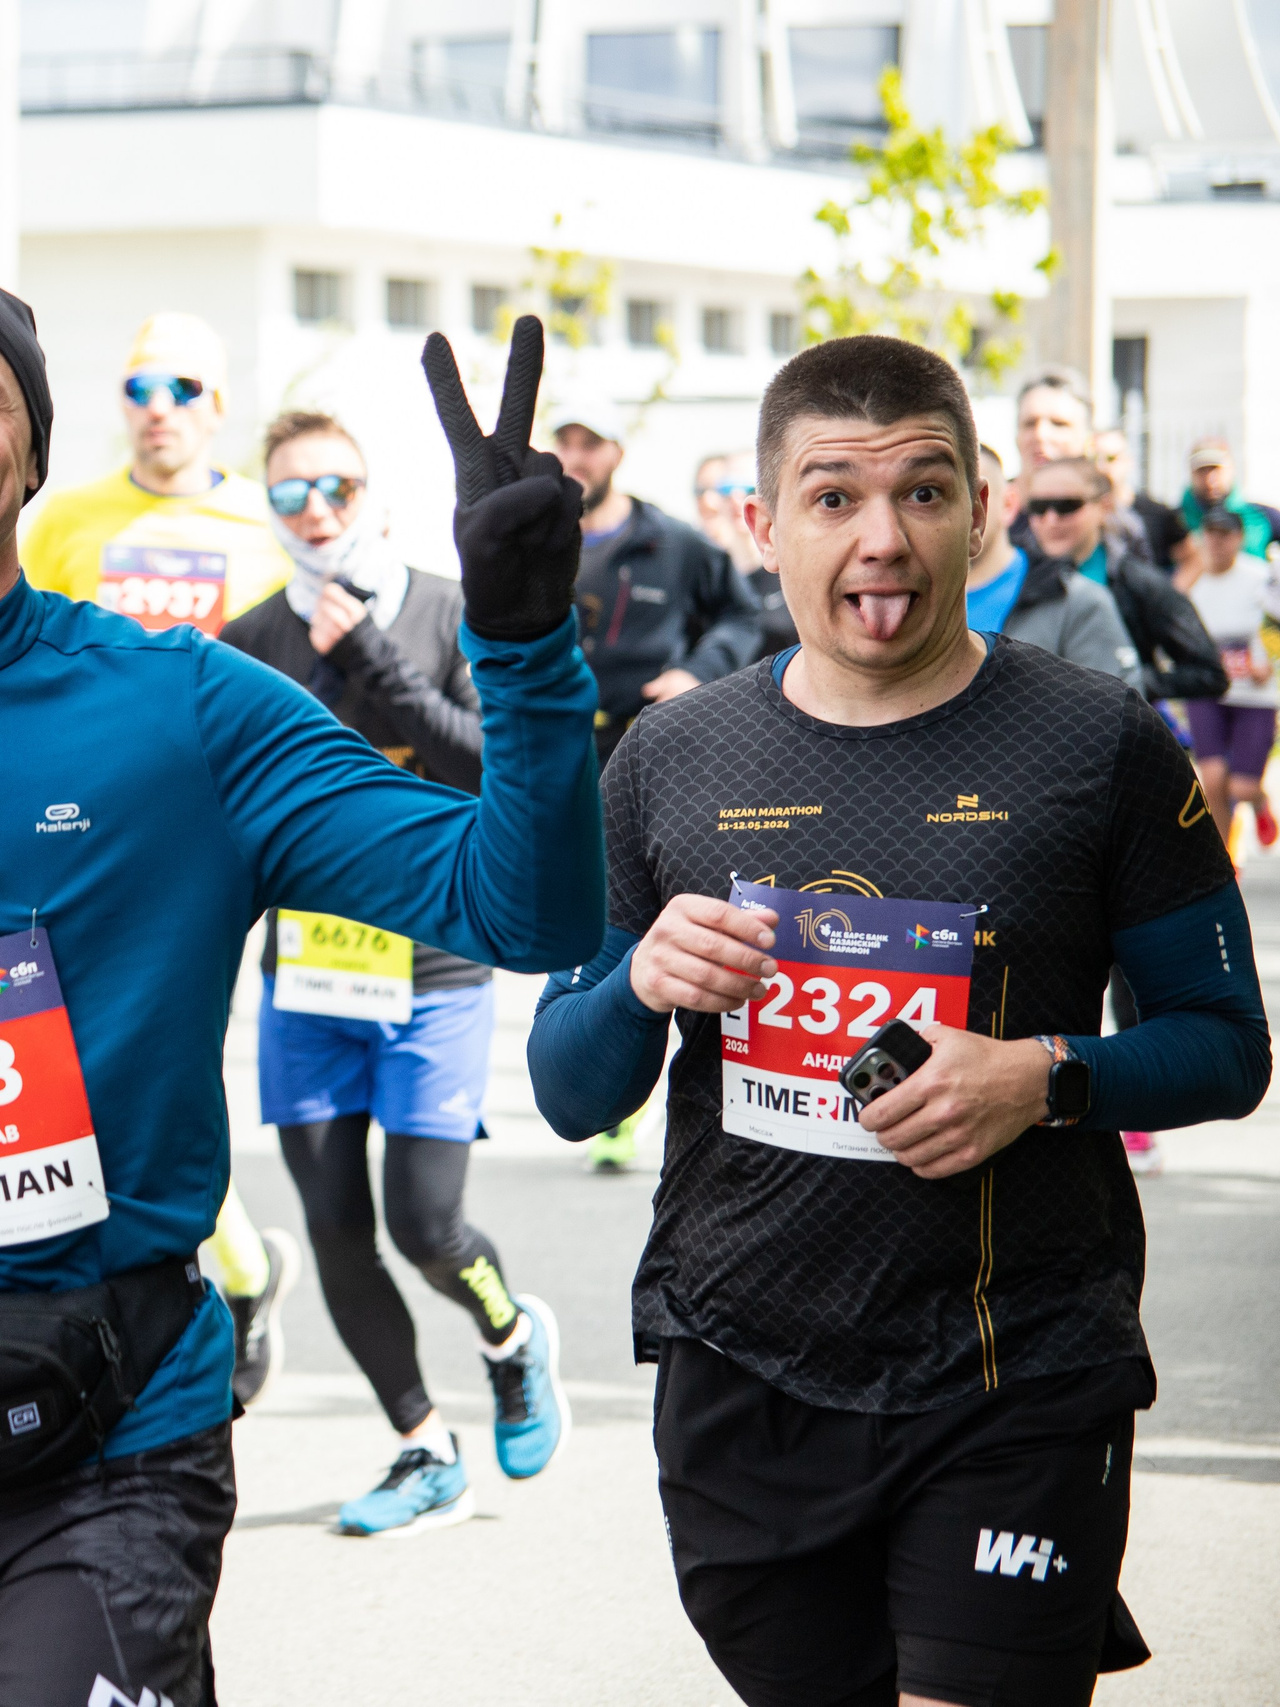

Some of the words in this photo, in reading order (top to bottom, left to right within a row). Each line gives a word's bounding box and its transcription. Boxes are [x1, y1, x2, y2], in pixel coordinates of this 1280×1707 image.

[719, 808, 757, 818] KAZAN
[758, 805, 823, 817] MARATHON
[926, 811, 1009, 823] NORDSKI
[717, 820, 790, 831] 11-12.05.2024
[310, 919, 390, 954] 6676
[830, 930, 842, 939] АК
[843, 931, 866, 940] БАРС
[865, 933, 889, 942] БАНК
[829, 938, 881, 949] КАЗАНСКИЙ
[829, 945, 870, 955] МАРАФОН
[758, 971, 942, 1038] 2324
[725, 1038, 749, 1055] 2024
[832, 1142, 869, 1153] Питание
